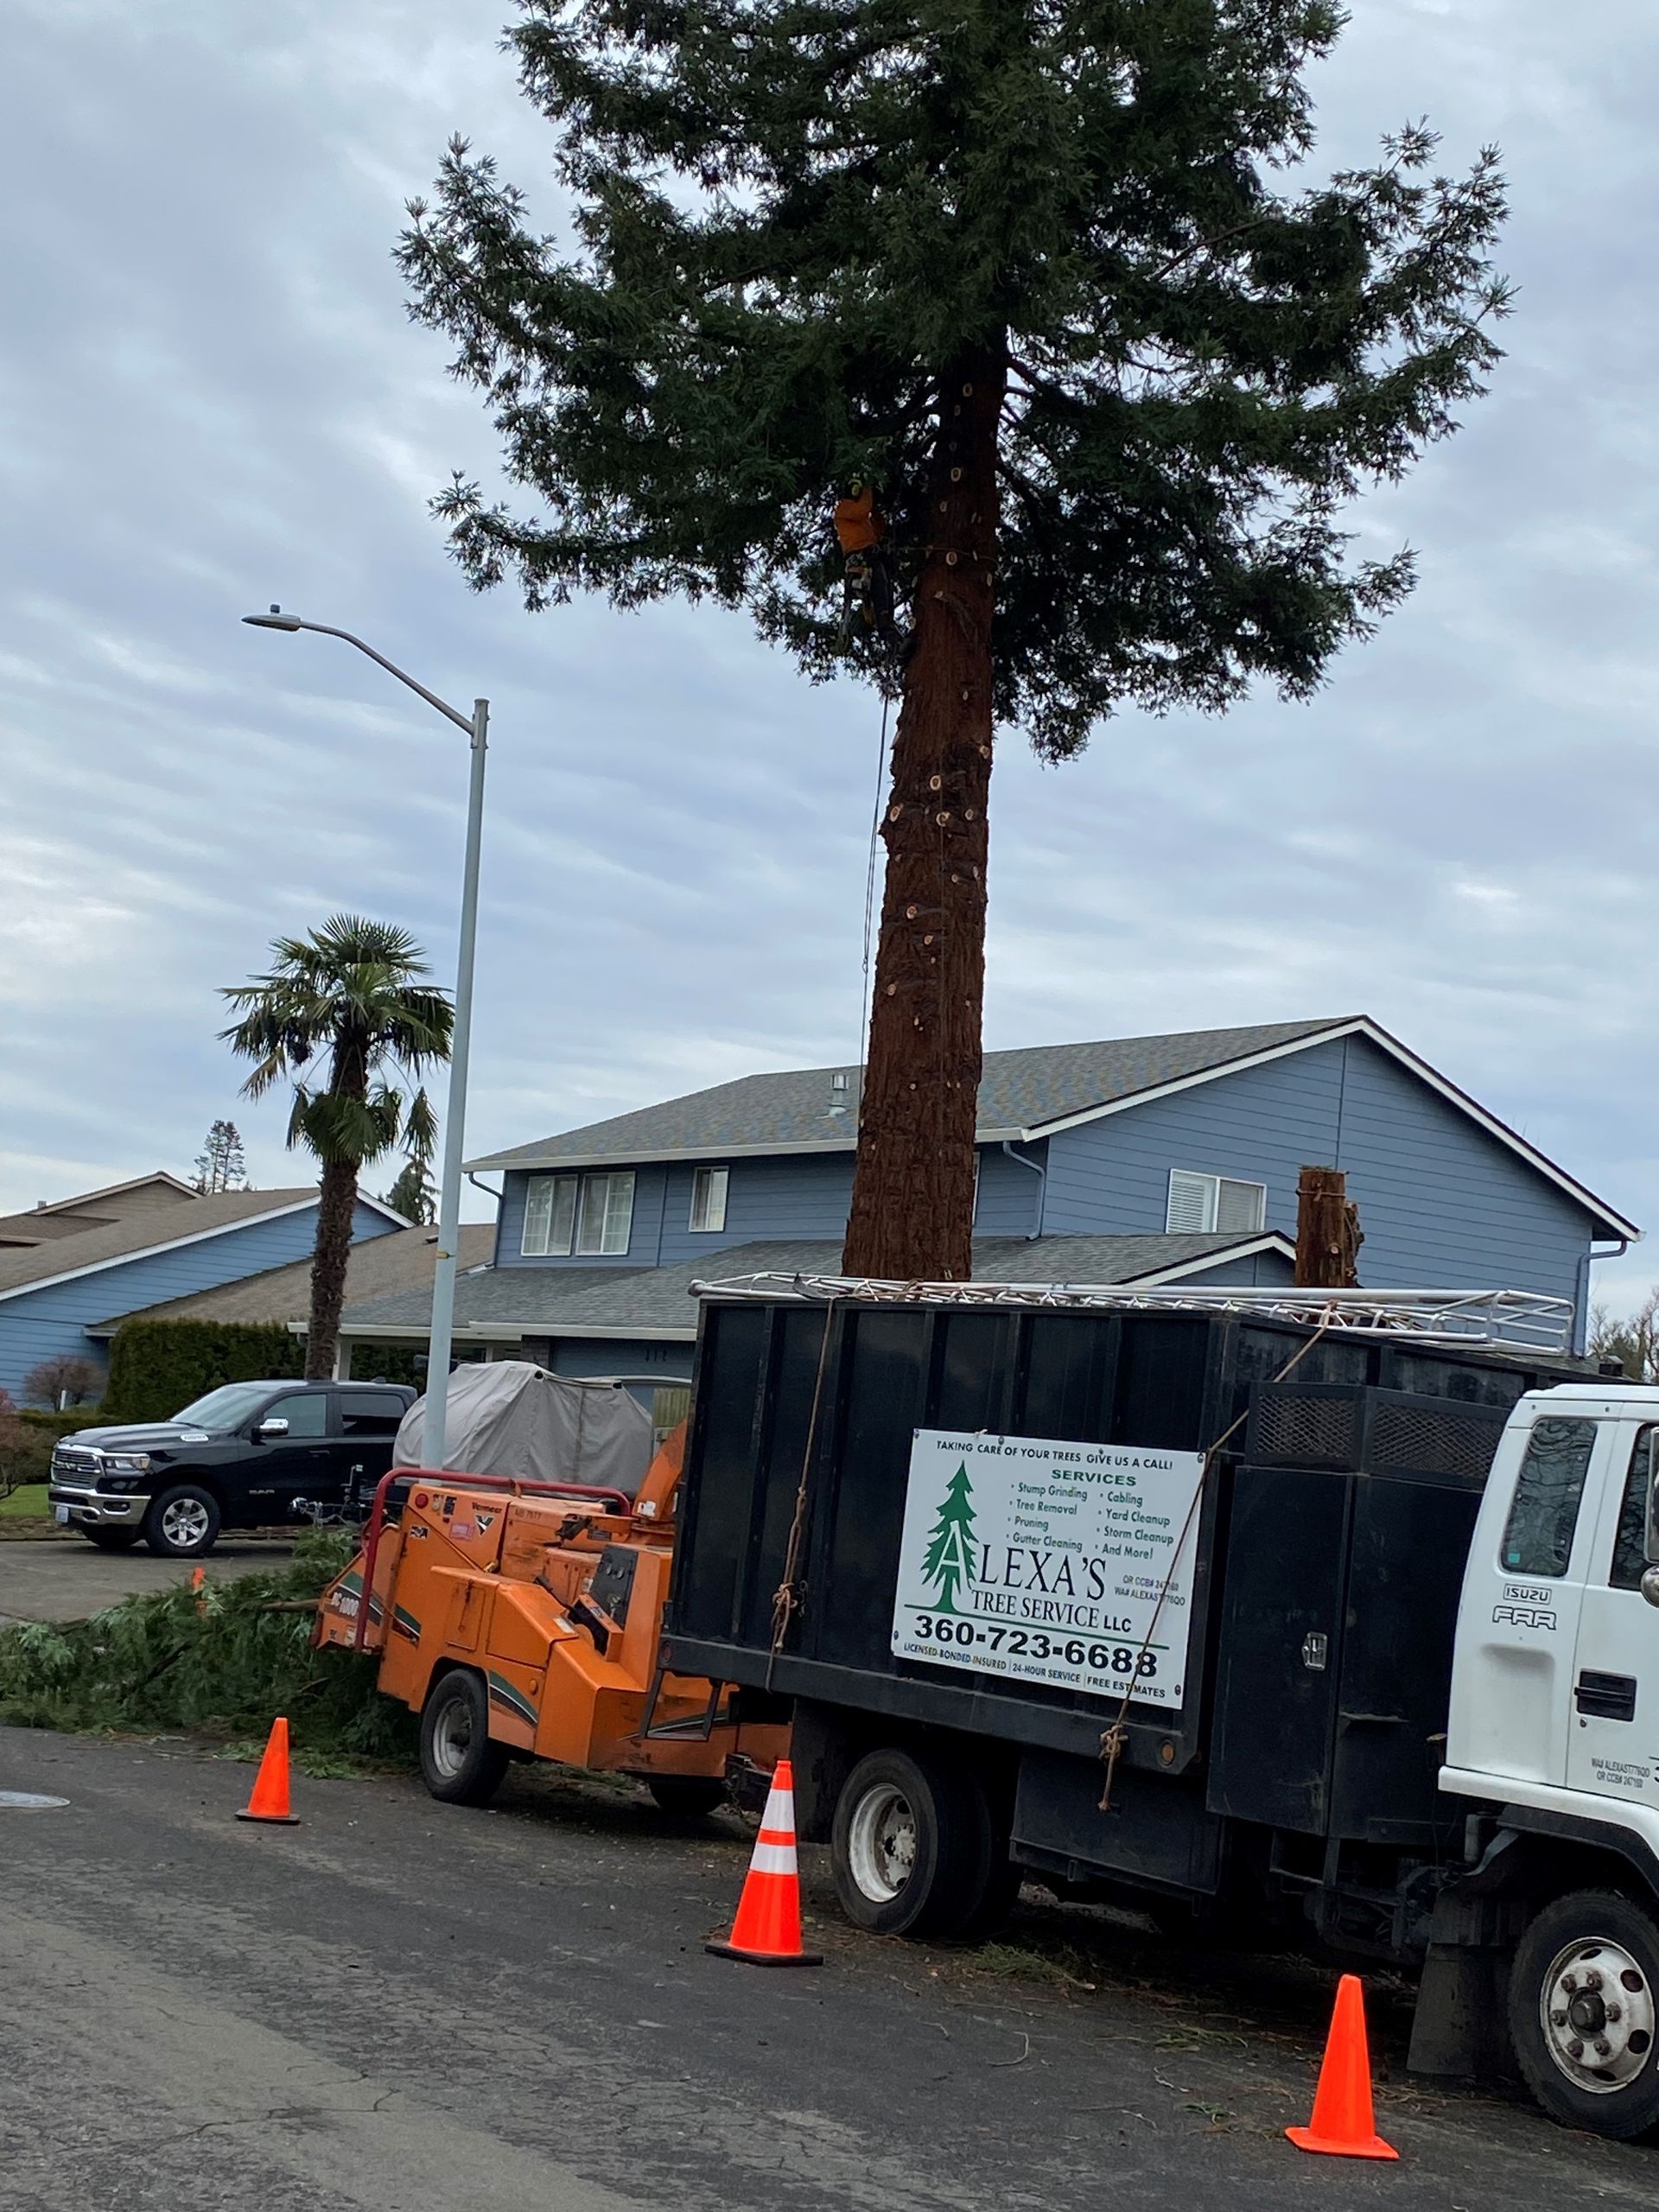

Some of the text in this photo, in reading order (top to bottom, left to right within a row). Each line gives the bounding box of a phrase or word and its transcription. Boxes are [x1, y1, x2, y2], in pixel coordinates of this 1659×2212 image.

[937, 1440, 1173, 1470] TAKING CARE OF YOUR TREES GIVE US A CALL!
[1051, 1469, 1137, 1487] SERVICES
[1018, 1482, 1088, 1503] Stump Grinding
[1107, 1491, 1143, 1509] Cabling
[1016, 1498, 1077, 1516] Tree Removal
[1014, 1516, 1049, 1532] Pruning
[1106, 1508, 1171, 1529] Yard Cleanup
[1013, 1532, 1083, 1554] Gutter Cleaning
[1103, 1525, 1174, 1548] Storm Cleanup
[1102, 1543, 1154, 1560] And More!
[1506, 1587, 1548, 1601] ISUZU
[971, 1589, 1132, 1633] TREE SERVICE LLC
[1492, 1605, 1556, 1630] FRR
[914, 1614, 1158, 1678] 360-723-6688
[1012, 1662, 1081, 1683] 24-HOUR SERVICE
[1087, 1676, 1166, 1699] FREE ESTMATES
